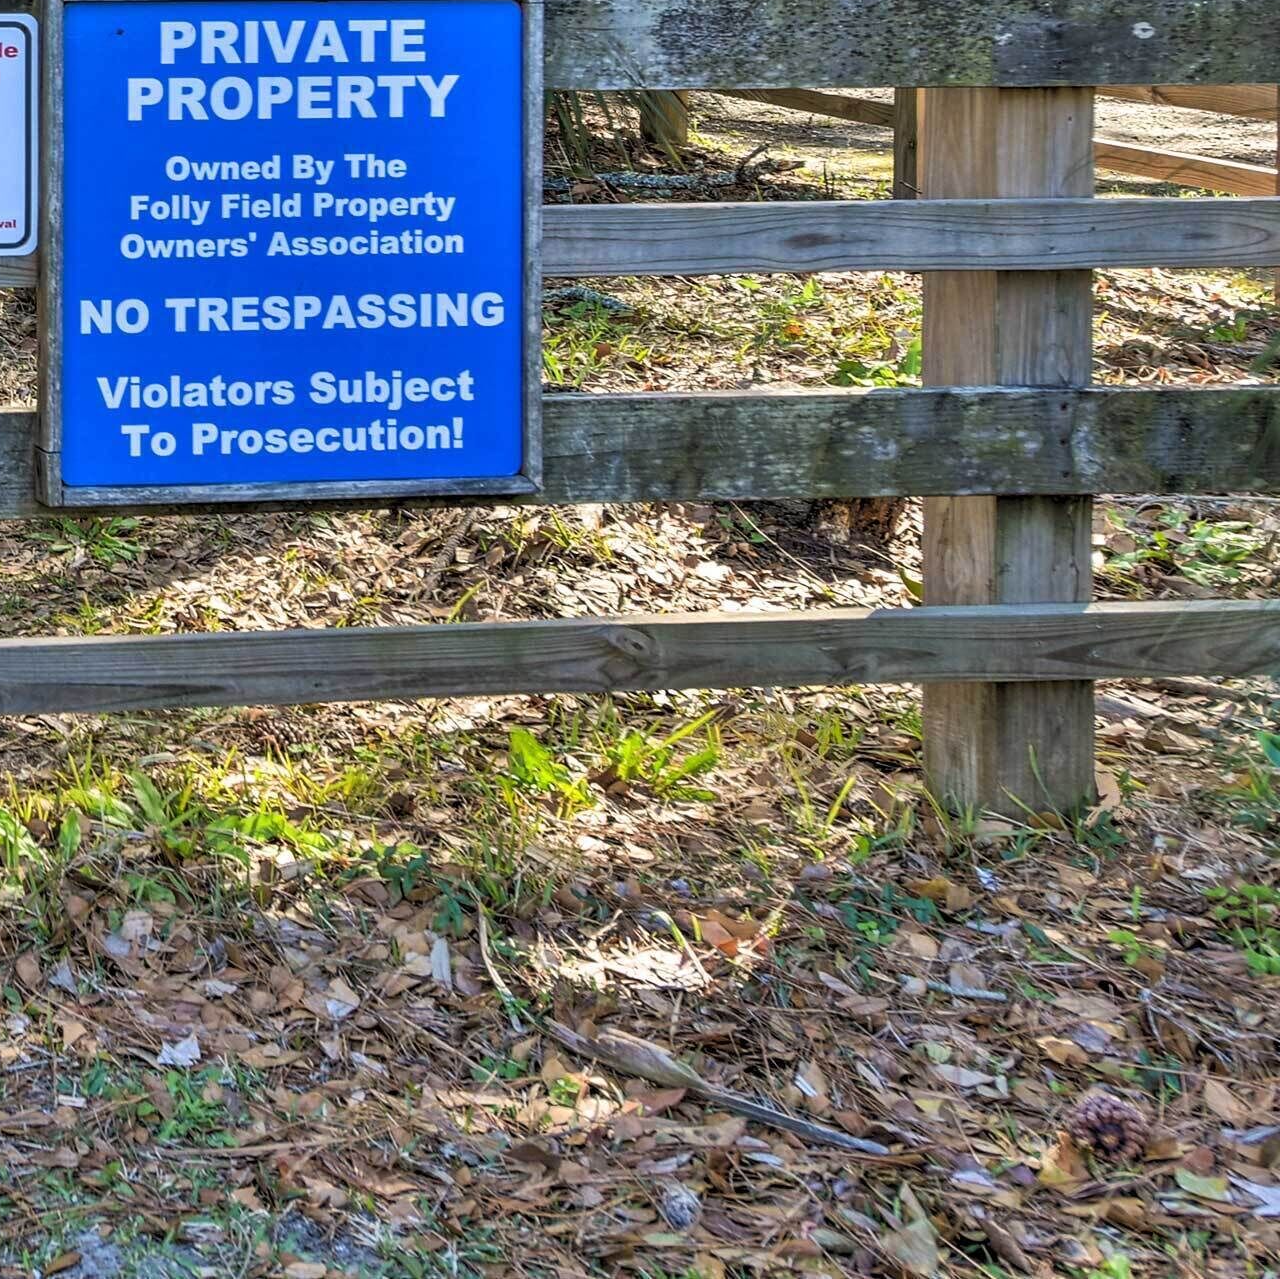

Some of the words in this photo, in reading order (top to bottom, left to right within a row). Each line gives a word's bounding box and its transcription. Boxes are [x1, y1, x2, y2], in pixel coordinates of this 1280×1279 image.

[160, 19, 426, 65] PRIVATE
[128, 74, 460, 121] PROPERTY
[166, 155, 280, 181] Owned
[293, 154, 334, 186] By
[344, 153, 407, 178] The
[131, 194, 210, 226] Folly
[222, 193, 301, 219] Field
[314, 191, 455, 223] Property
[120, 232, 257, 259] Owners'
[267, 229, 464, 256] Association
[80, 299, 149, 334] NO
[165, 292, 504, 332] TRESPASSING
[97, 375, 295, 409] Violators
[310, 370, 474, 411] Subject
[121, 424, 176, 457] To
[192, 417, 463, 455] Prosecution!
